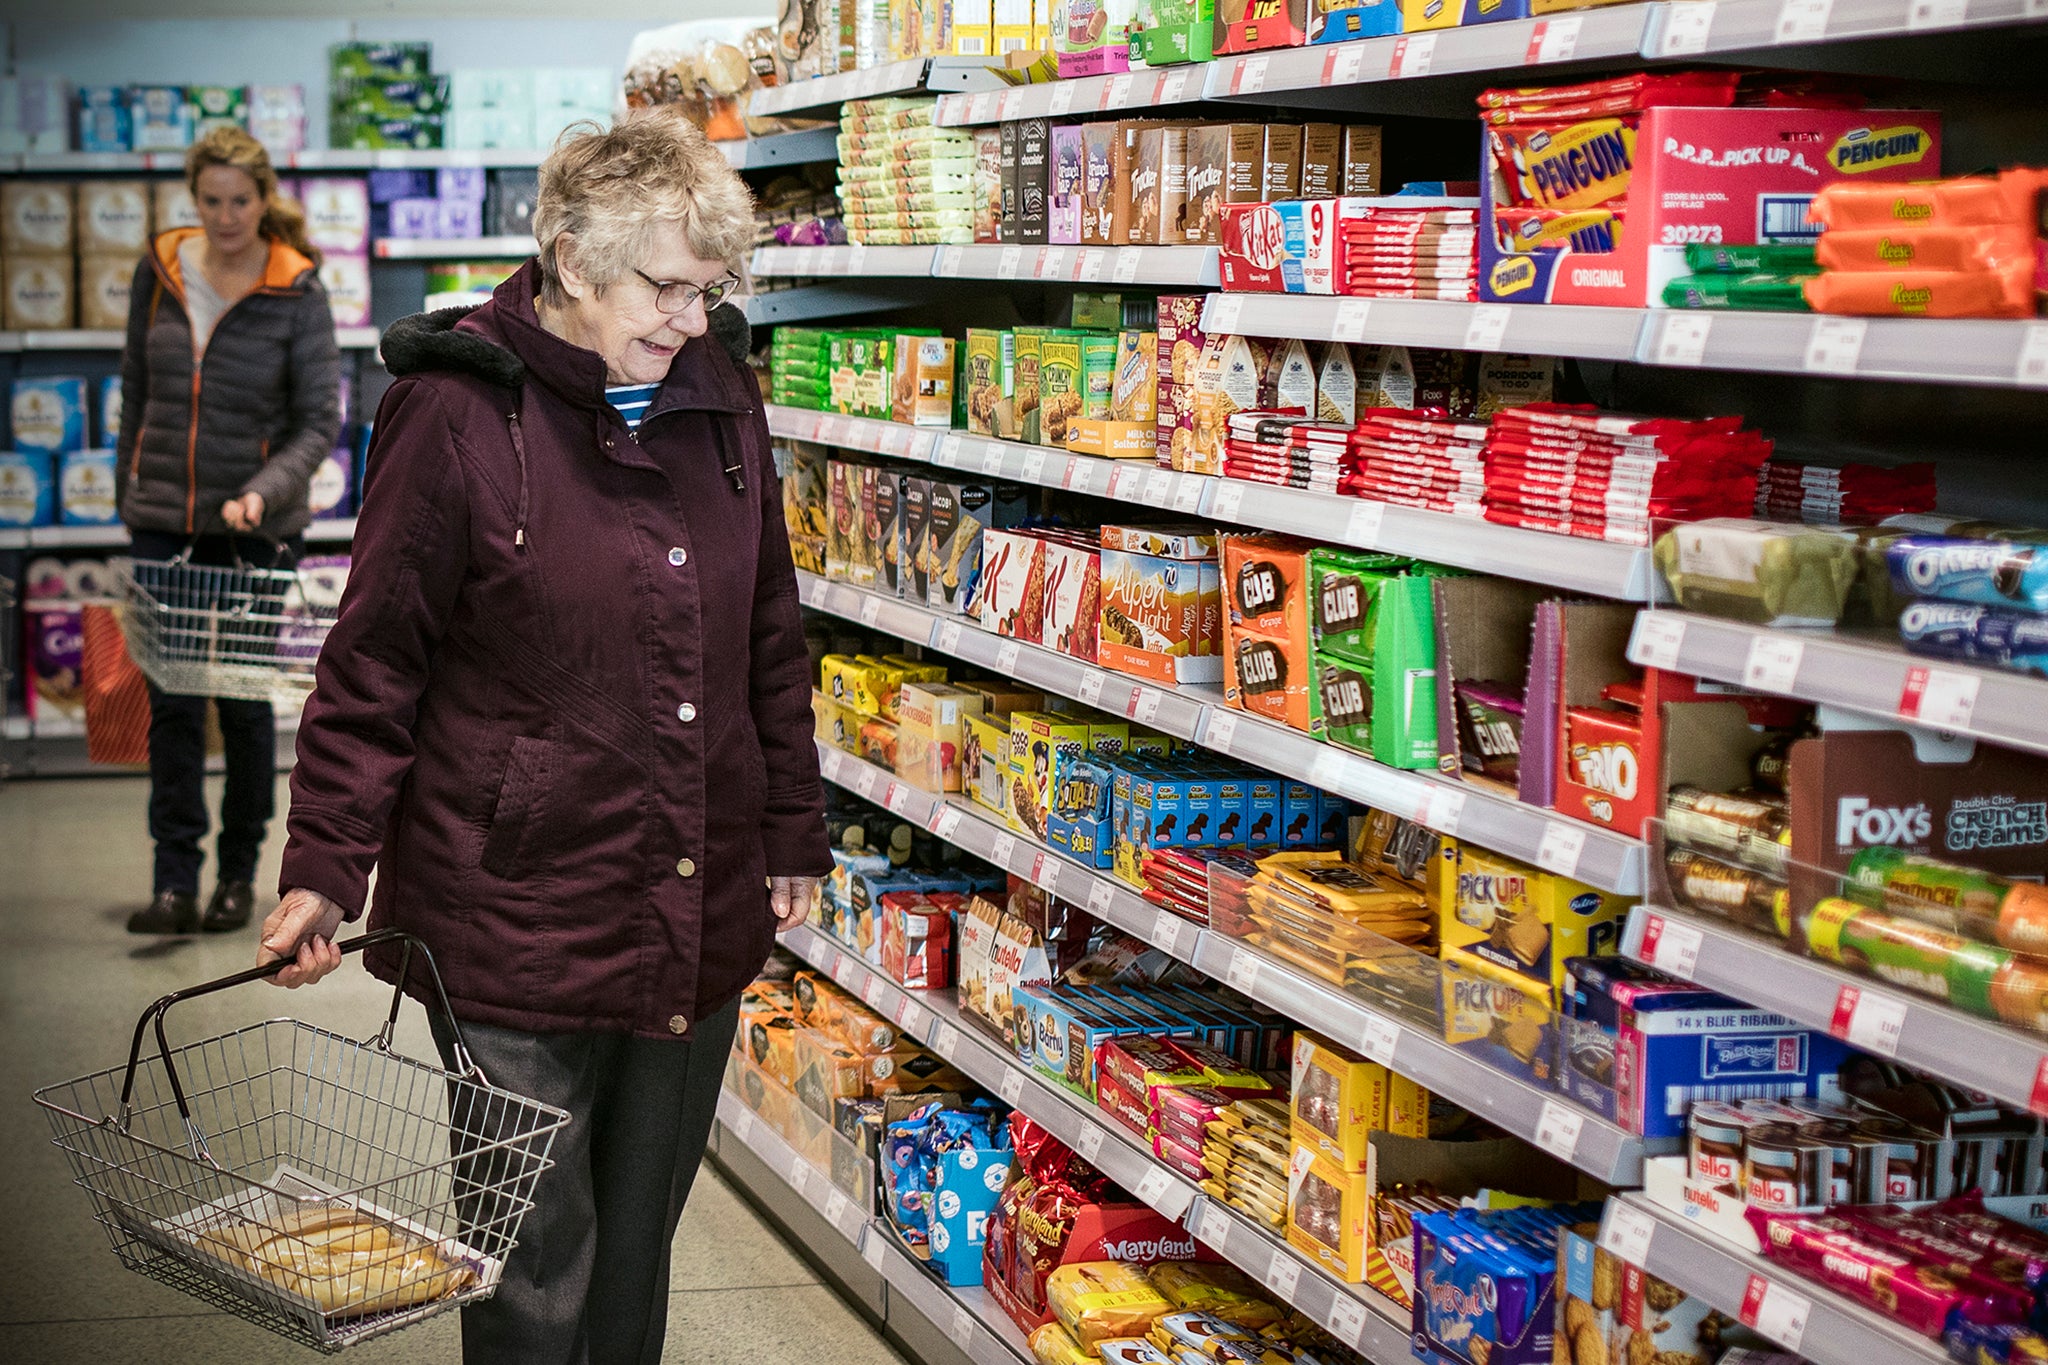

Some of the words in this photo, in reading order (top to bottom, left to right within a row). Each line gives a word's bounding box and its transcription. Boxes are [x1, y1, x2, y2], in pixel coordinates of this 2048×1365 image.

[1530, 127, 1633, 205] PENGUIN
[1837, 132, 1921, 168] PENGUIN
[1188, 162, 1221, 202] Tracker
[1311, 203, 1324, 246] 9
[1661, 225, 1722, 244] 30273
[1244, 215, 1283, 269] KitKat
[1571, 269, 1626, 288] ORIGINAL
[1487, 370, 1545, 381] PORRIDGE
[1126, 429, 1146, 440] Milk
[1106, 559, 1169, 613] Alpen
[1138, 602, 1173, 635] Light
[1323, 584, 1359, 624] CLUB
[1258, 615, 1283, 629] Orange
[1242, 649, 1278, 685] CLUB
[1326, 679, 1364, 717] CLUB
[1011, 730, 1029, 749] COCO
[1095, 739, 1123, 753] COCO
[1474, 720, 1520, 756] CLUB
[1579, 744, 1639, 801] TRIO
[1949, 802, 2046, 829] CRUNCH
[1954, 798, 1990, 810] Double
[1991, 795, 2016, 806] Choc
[1948, 826, 2048, 851] creams
[991, 937, 1022, 976] nutella
[1019, 976, 1050, 989] nutella
[1676, 1017, 1692, 1028] 14
[1706, 1015, 1737, 1028] BLUE
[1740, 1013, 1786, 1027] RIBAND
[1038, 1023, 1064, 1057] Barny
[1104, 1235, 1197, 1262] Maryland
